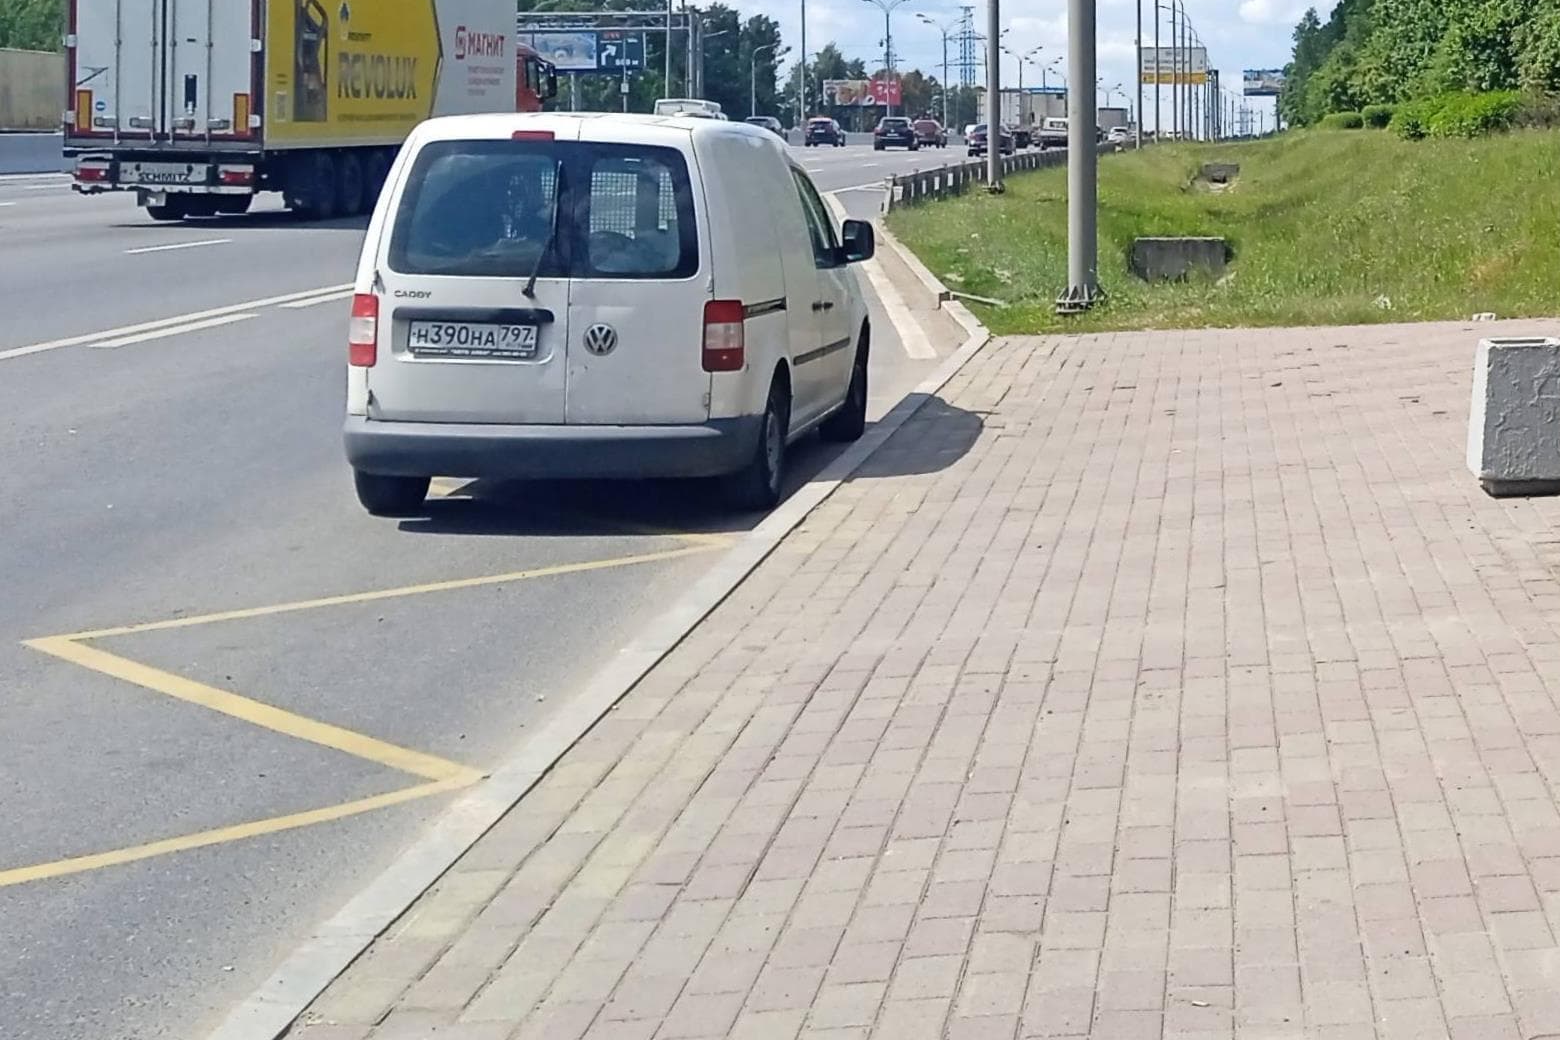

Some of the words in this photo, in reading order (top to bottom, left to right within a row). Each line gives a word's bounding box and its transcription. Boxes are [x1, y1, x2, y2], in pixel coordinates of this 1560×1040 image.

[467, 32, 504, 57] МАГНИТ
[337, 51, 417, 99] REVOLUX
[394, 290, 432, 299] CADDY
[416, 324, 496, 347] Н390НА
[500, 326, 531, 343] 797
